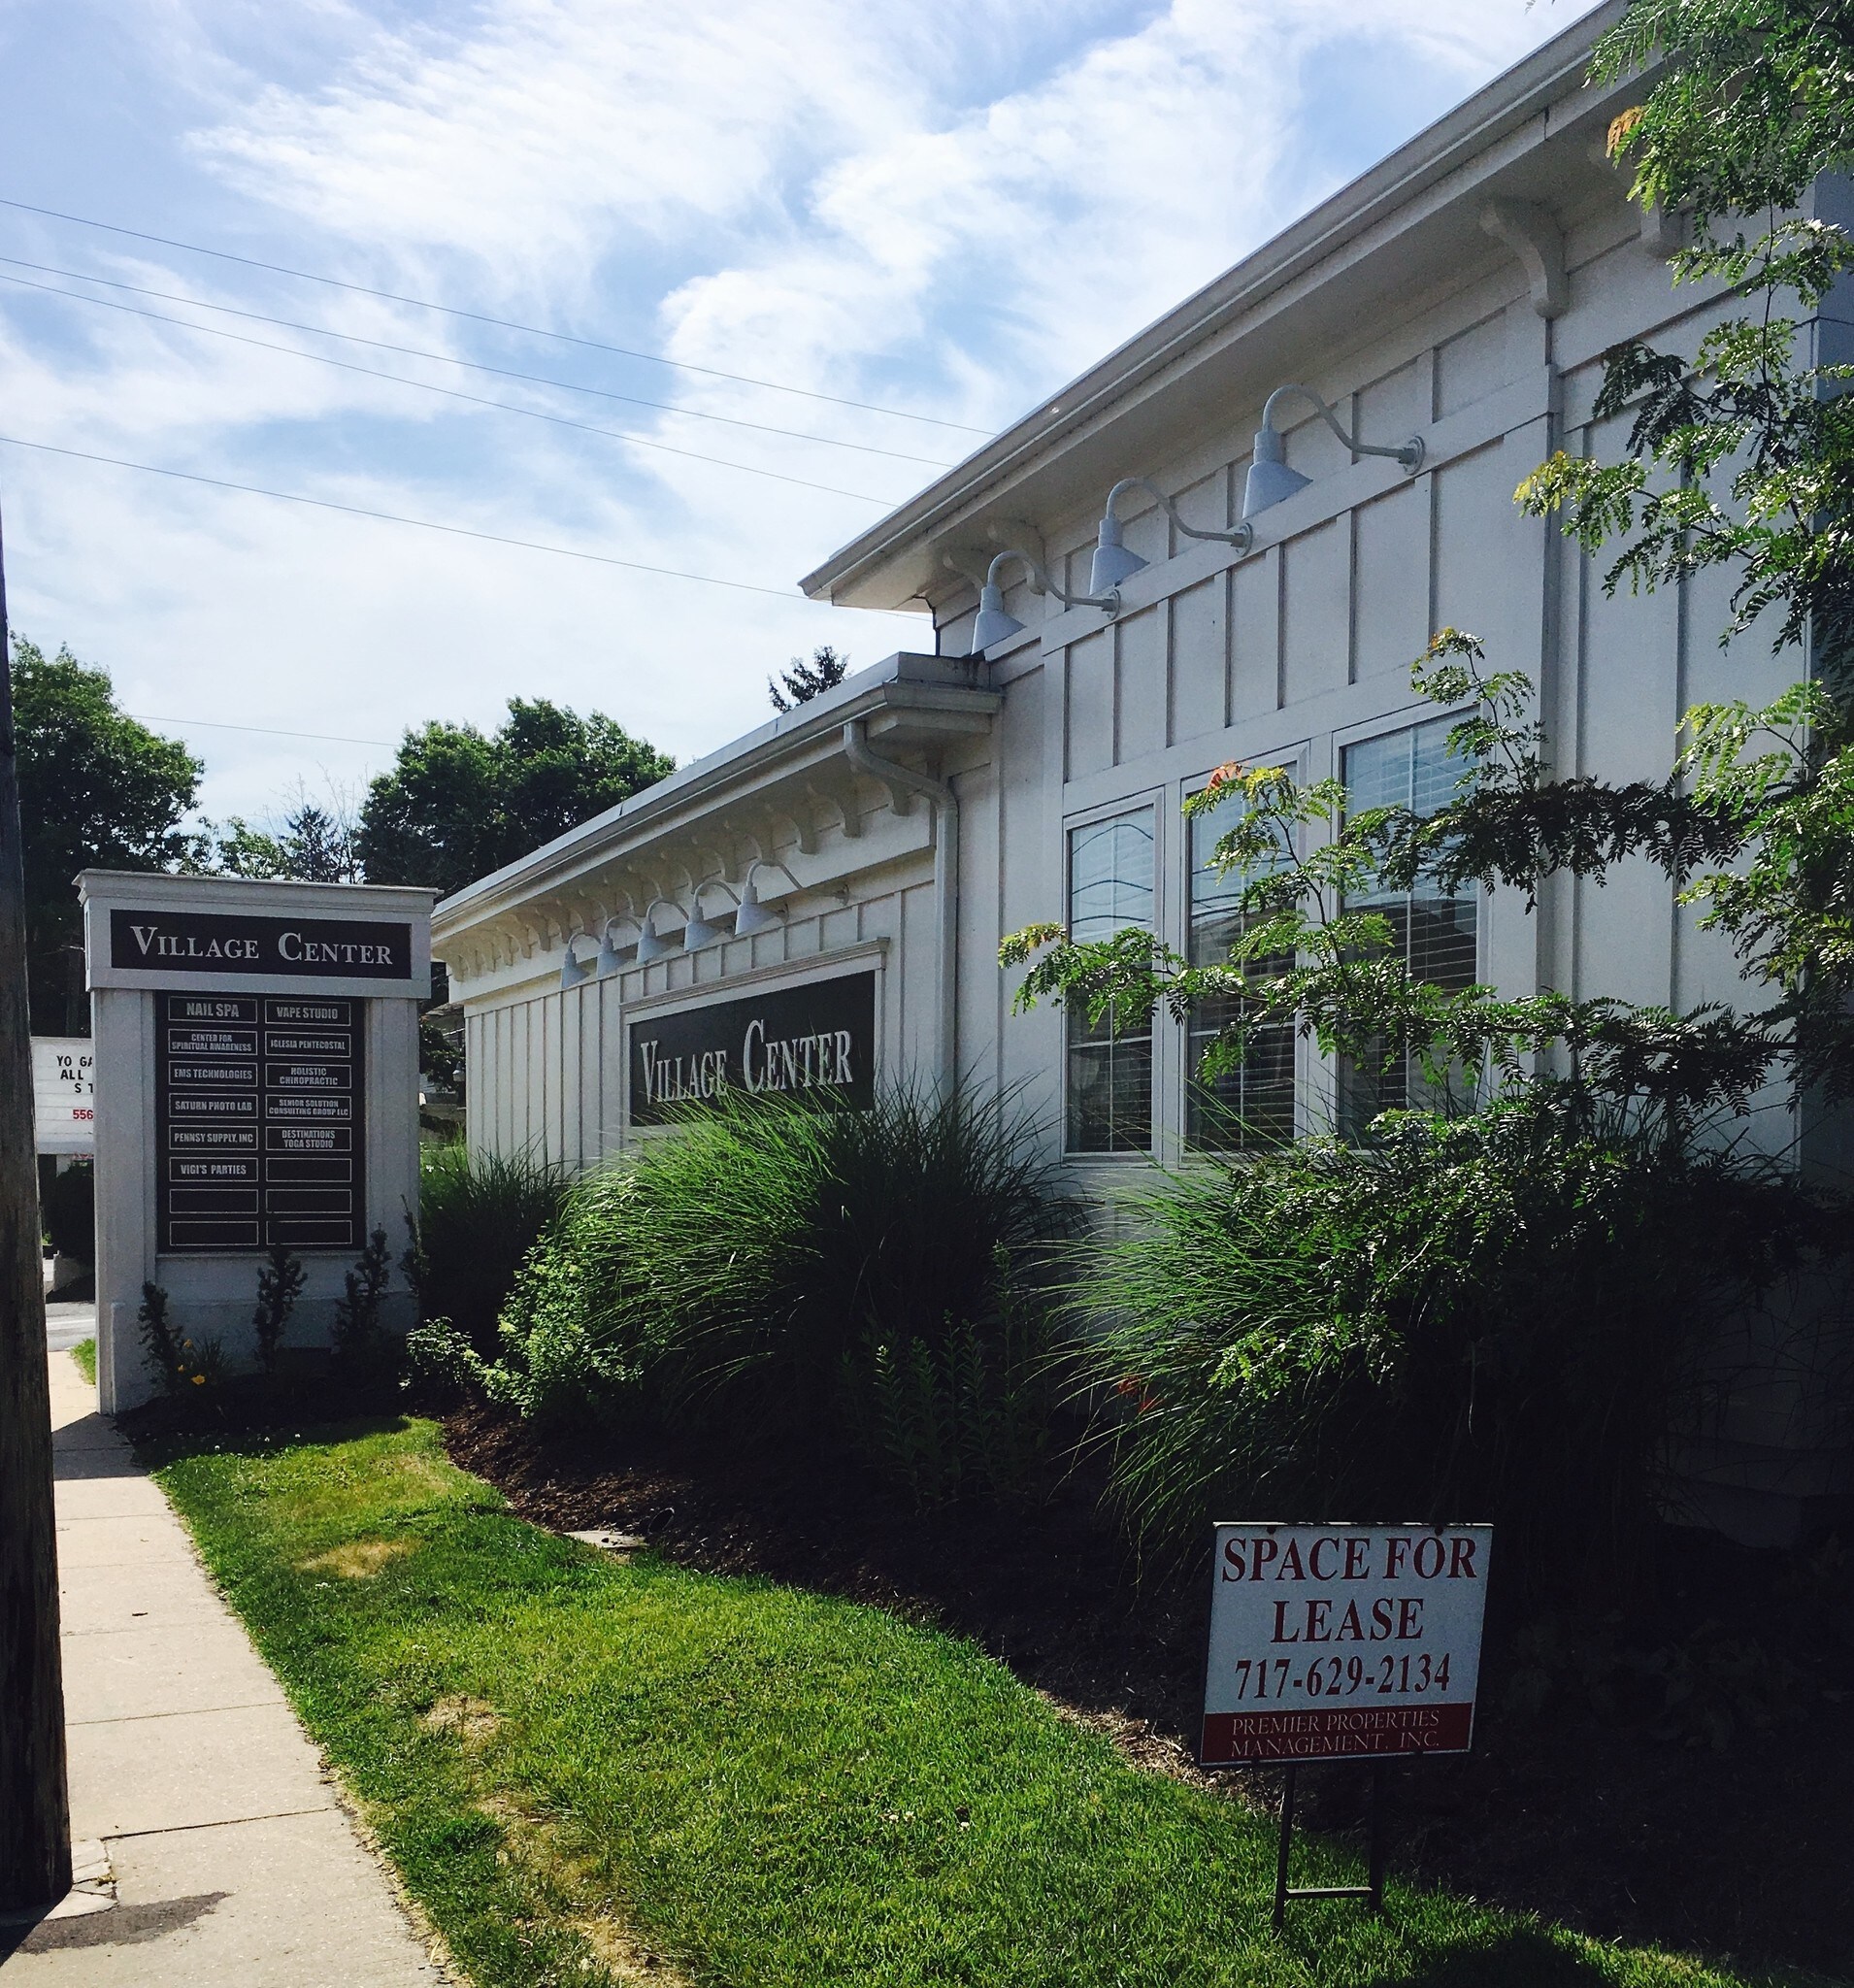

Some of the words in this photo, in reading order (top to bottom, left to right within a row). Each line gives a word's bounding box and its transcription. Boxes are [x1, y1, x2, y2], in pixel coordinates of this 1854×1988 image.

[129, 925, 260, 959] VILLAGE
[278, 932, 393, 965] CENTER
[186, 1003, 214, 1016] NAIL
[215, 1003, 240, 1017] SPA
[277, 1007, 301, 1018] VAPE
[303, 1008, 338, 1019] STUDIO
[218, 1034, 233, 1042] FOR
[172, 1042, 209, 1050] SPIRITUAL
[210, 1043, 251, 1051] AWARENESS
[271, 1040, 298, 1048] IGLESIA
[299, 1041, 346, 1050] PENTECOSTAL
[640, 1040, 728, 1105] VILLAGE
[743, 1019, 853, 1095] CENTER
[60, 1069, 83, 1080] ALL
[174, 1069, 192, 1077] EMS
[193, 1069, 252, 1079] TECHNOLOGIES
[291, 1067, 327, 1076] HOLISTIC
[279, 1076, 338, 1085] CHIROPRACTIC
[175, 1101, 207, 1110] SATURN
[208, 1101, 236, 1111] PHOTO
[237, 1102, 252, 1111] LAB
[279, 1099, 304, 1107] SENIOR
[269, 1107, 311, 1115] CONSULTING
[175, 1133, 205, 1143] PENNSY
[239, 1133, 253, 1143] INC
[281, 1130, 336, 1139] DESTINATIONS
[283, 1139, 304, 1148] YOGA
[305, 1139, 334, 1148] STUDIO
[181, 1165, 207, 1175] VIGI'S
[211, 1165, 247, 1175] PARTIES
[1221, 1538, 1371, 1582] SPACE
[1382, 1537, 1477, 1579] FOR
[1270, 1598, 1424, 1643] LEASE
[1234, 1653, 1449, 1700] 717-629-2134
[1233, 1715, 1320, 1736] PREMIER
[1327, 1709, 1440, 1731] PROPERTIES
[1400, 1730, 1440, 1748] INC.
